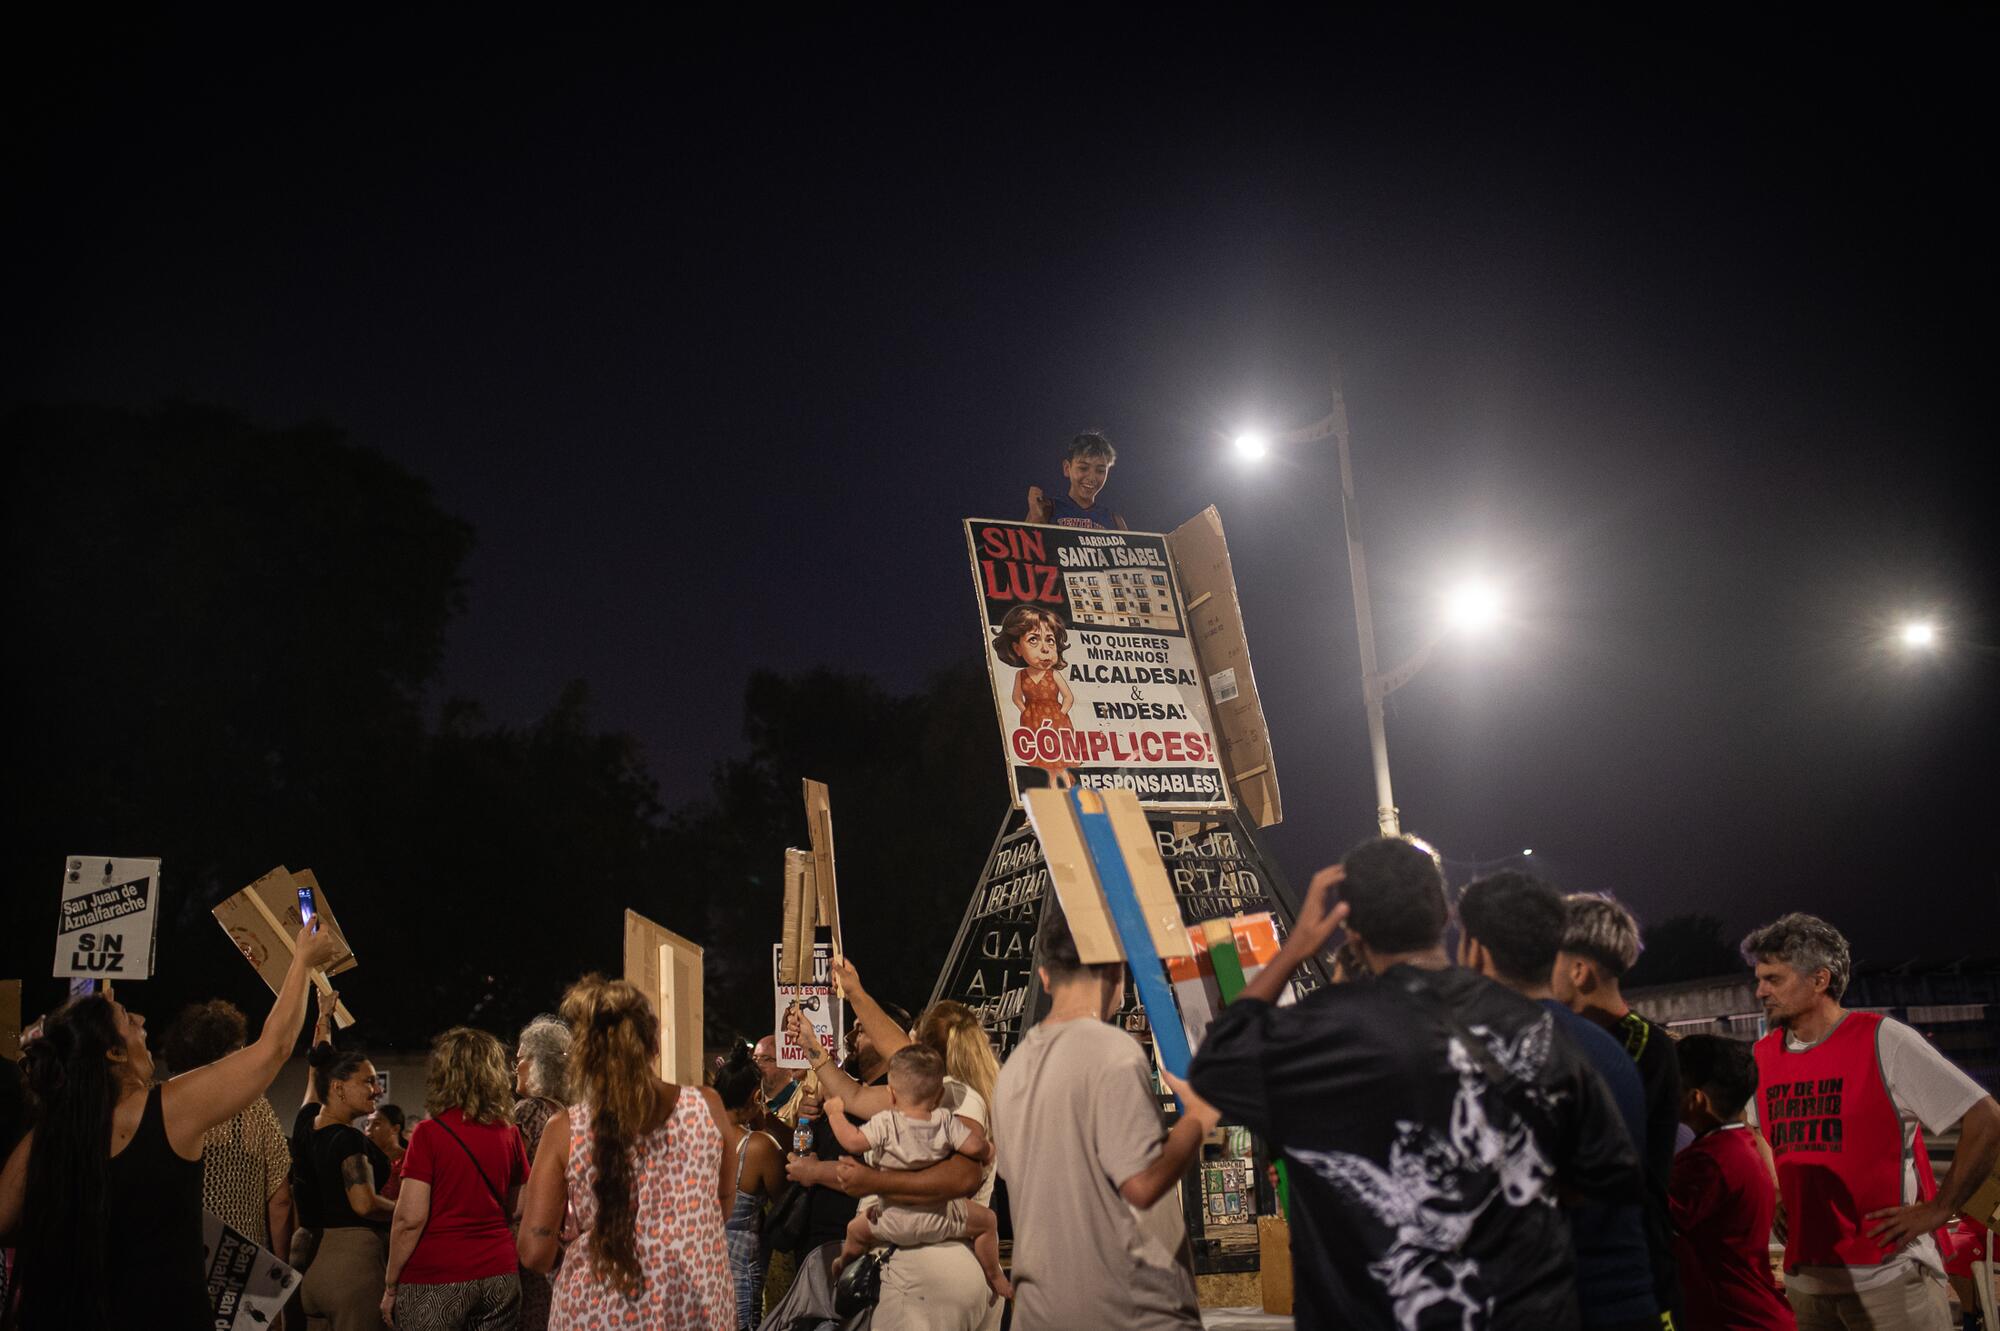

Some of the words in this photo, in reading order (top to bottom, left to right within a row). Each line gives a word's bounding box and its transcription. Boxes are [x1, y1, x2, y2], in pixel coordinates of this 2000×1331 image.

[982, 527, 1047, 562] SIN
[1078, 536, 1126, 547] BARRIADA
[1057, 547, 1109, 567] SANTA
[1110, 547, 1166, 567] ISABEL
[982, 560, 1064, 603] LUZ
[1080, 632, 1101, 646] NO
[1106, 636, 1170, 650] QUIERES
[1087, 647, 1169, 663] MIRARNOS!
[1069, 664, 1197, 686] ALCALDESA!
[1130, 685, 1144, 701] &
[1092, 702, 1187, 720] ENDESA!
[1012, 720, 1215, 762] CÓMPLICES!
[1080, 774, 1220, 793] RESPONSABLES!
[64, 899, 88, 915] San
[90, 890, 120, 907] Juan
[121, 884, 138, 898] de
[64, 897, 146, 932] Aznalfarache
[71, 952, 124, 972] LUZ
[781, 987, 790, 995] LA
[805, 987, 814, 995] ES
[820, 1034, 834, 1047] DE
[1766, 1083, 1791, 1101] SOY
[1794, 1081, 1814, 1096] DE
[1818, 1077, 1843, 1094] UN
[233, 1243, 257, 1273] San
[218, 1277, 244, 1315] Juan
